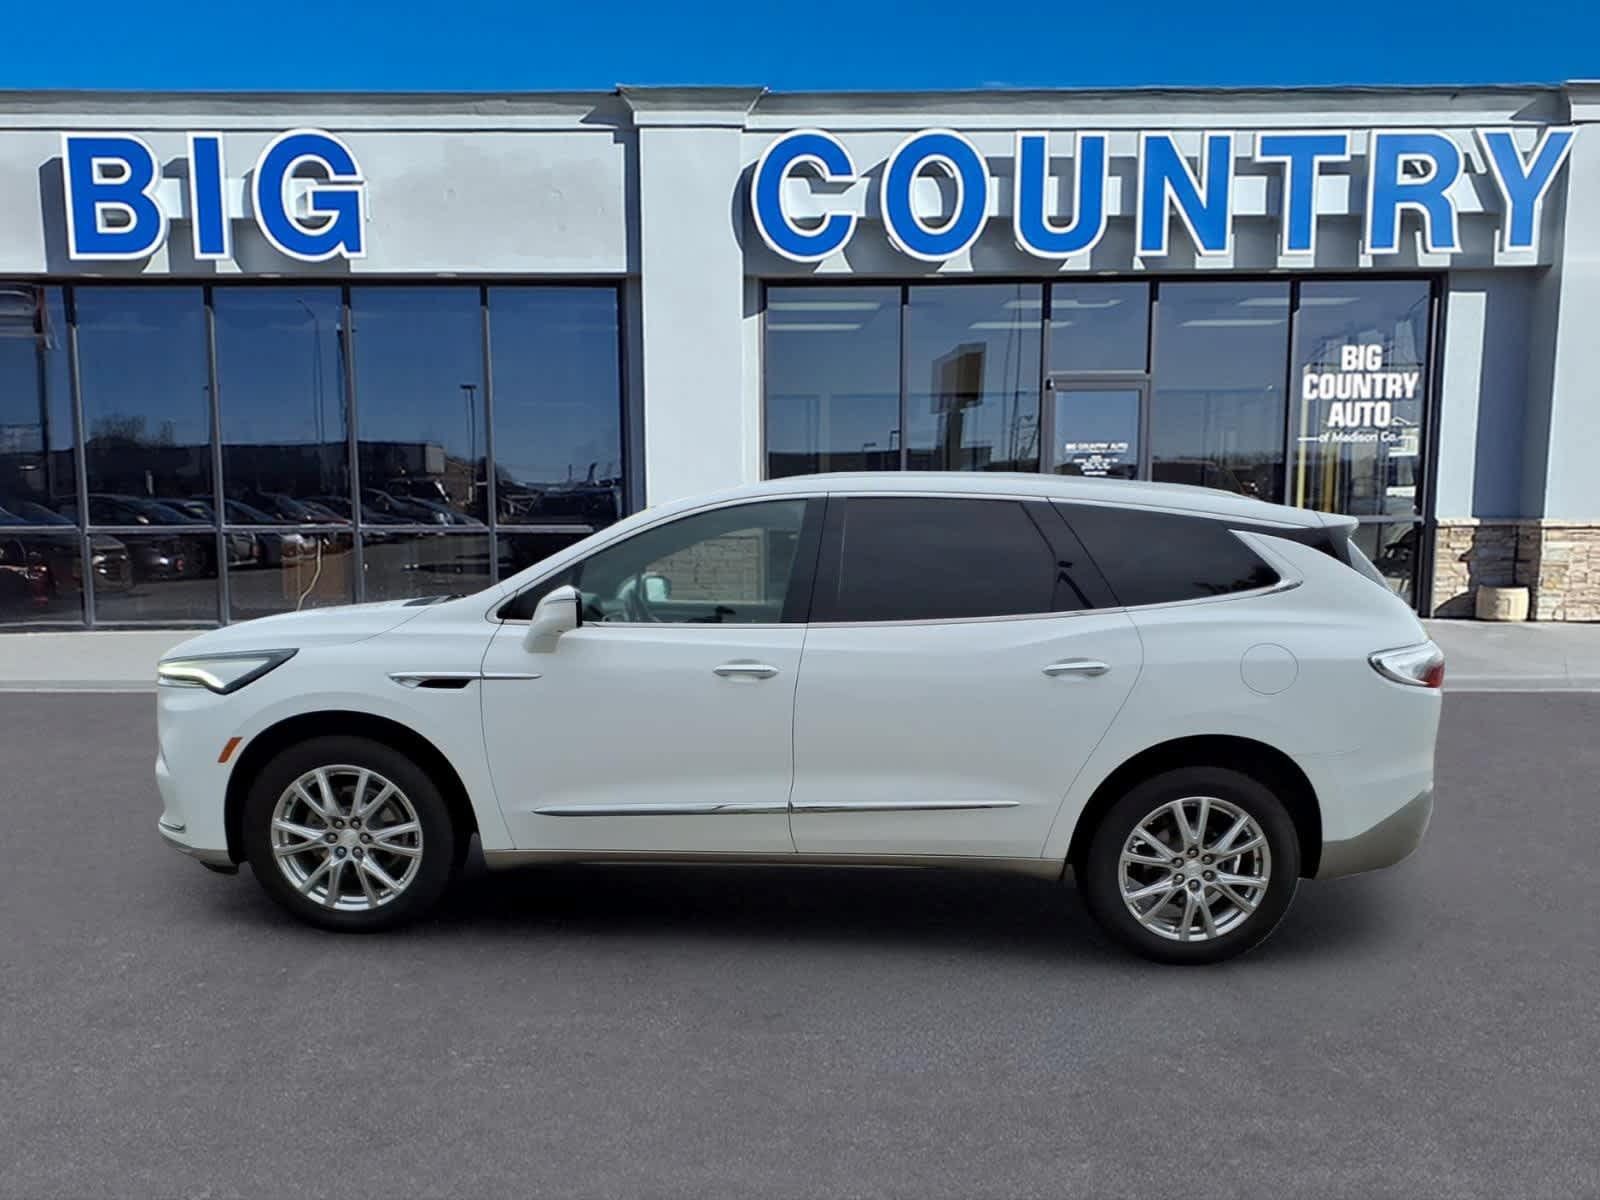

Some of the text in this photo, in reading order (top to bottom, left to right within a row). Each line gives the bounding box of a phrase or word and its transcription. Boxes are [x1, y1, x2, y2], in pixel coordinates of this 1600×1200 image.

[61, 127, 1577, 262] BIG COUNTRY
[1341, 344, 1383, 371] BIG
[1303, 372, 1420, 400] COUNTRY
[1327, 401, 1392, 428] AUTO
[1319, 432, 1329, 443] of
[1331, 432, 1379, 443] Madison
